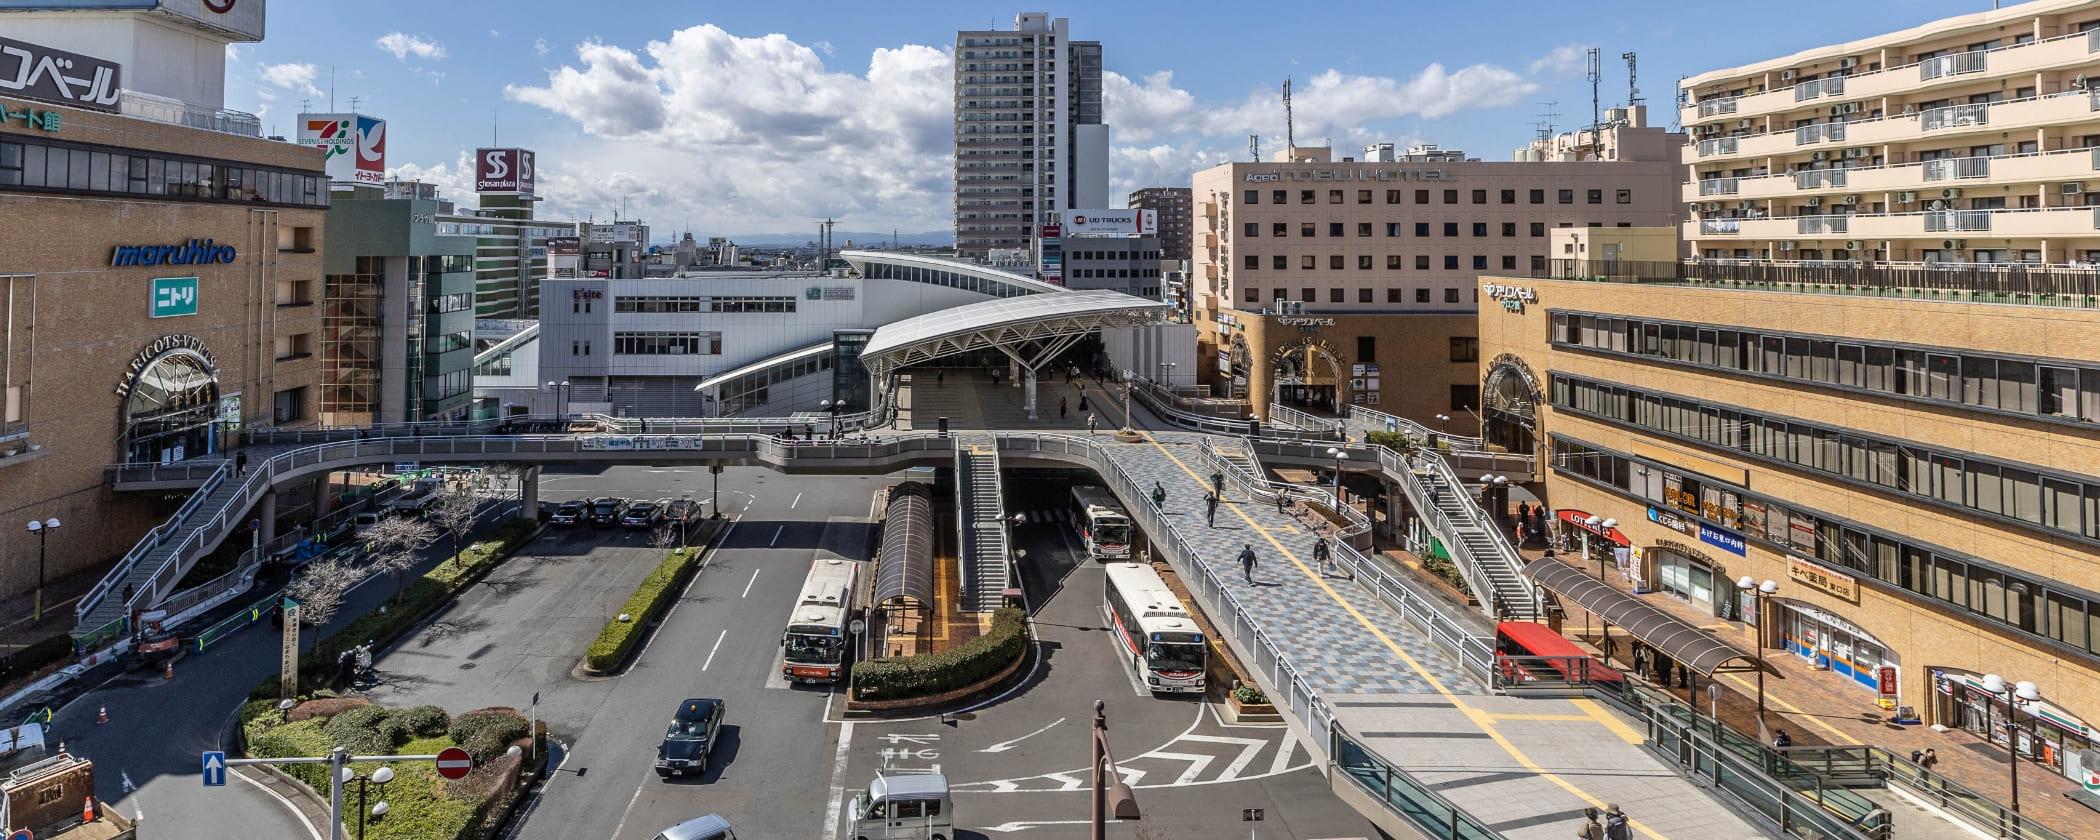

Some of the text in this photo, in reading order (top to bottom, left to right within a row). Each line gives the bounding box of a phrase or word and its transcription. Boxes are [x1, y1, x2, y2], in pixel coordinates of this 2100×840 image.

[1245, 168, 1457, 183] Ageo TOBU HOTEL
[112, 238, 236, 267] maruhiro
[158, 286, 194, 307] ニトリ
[1701, 527, 1745, 551] あげお東口内科
